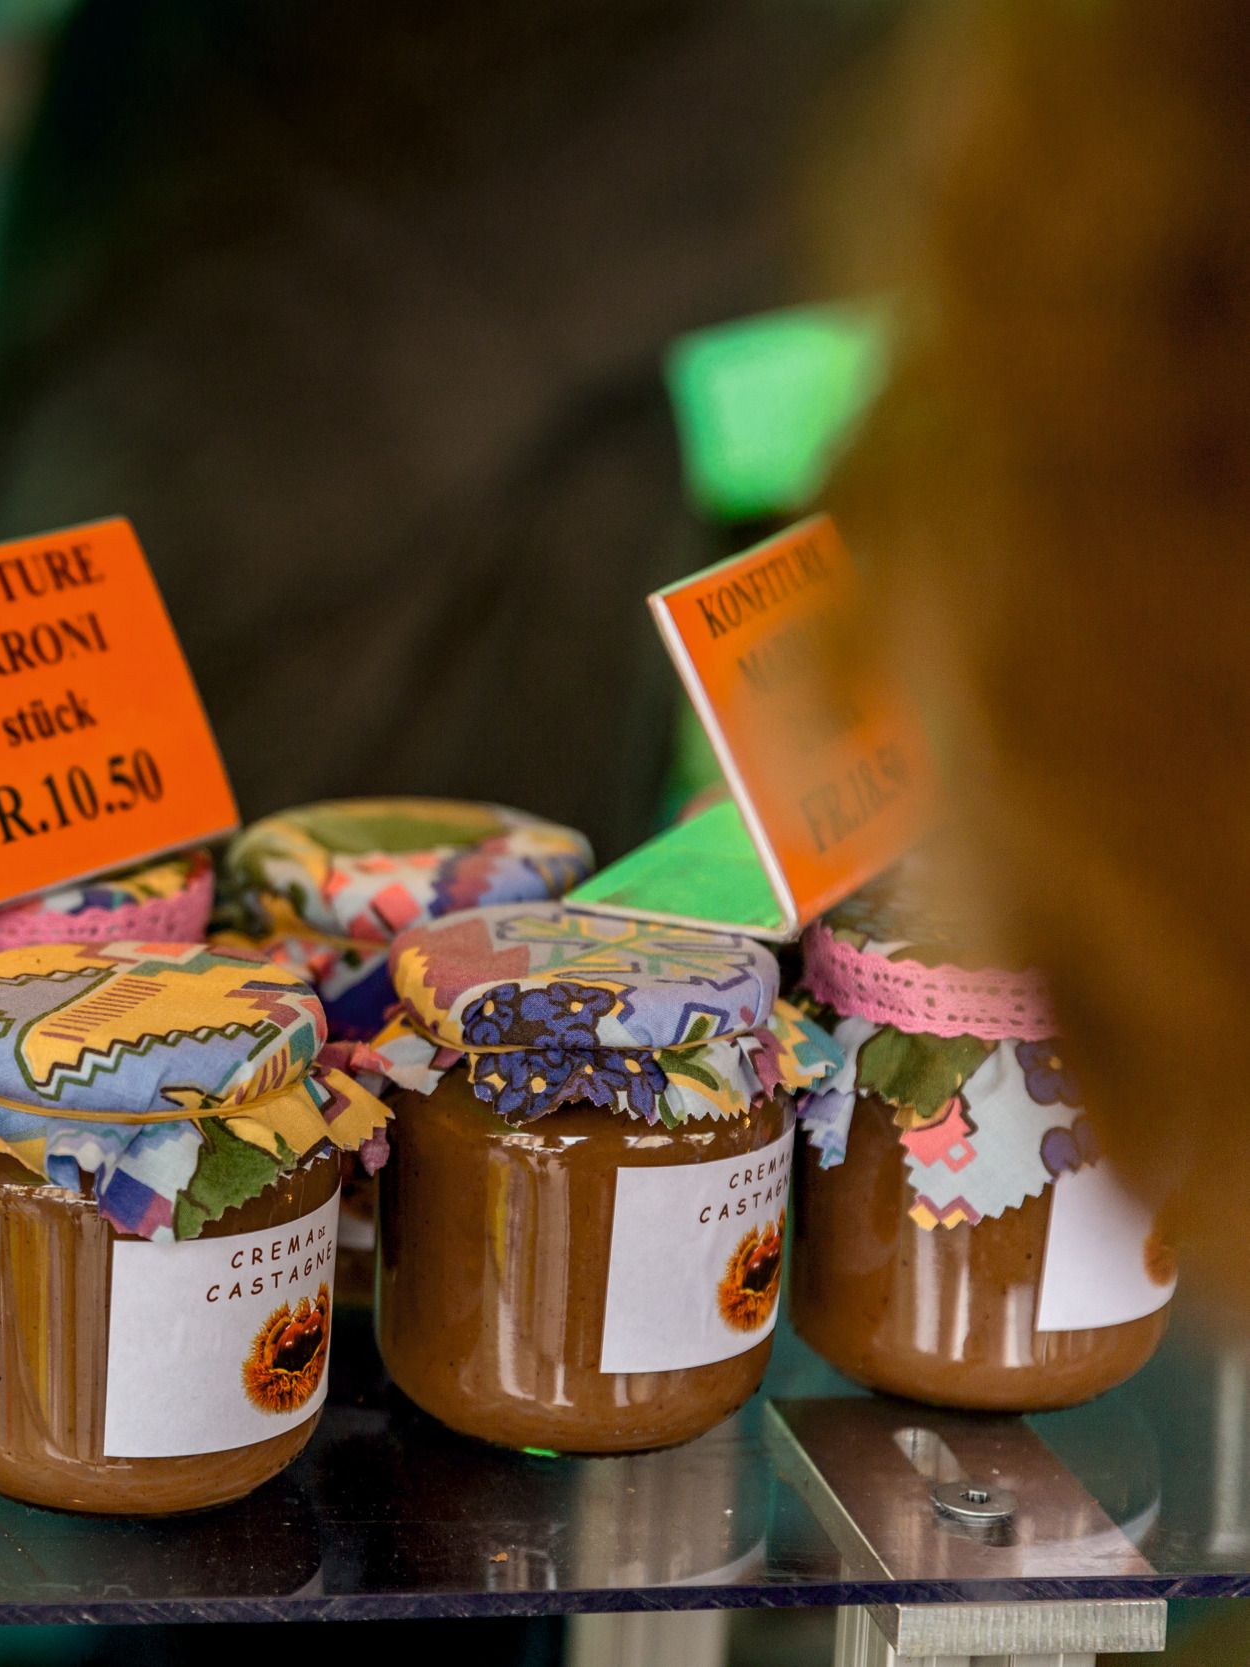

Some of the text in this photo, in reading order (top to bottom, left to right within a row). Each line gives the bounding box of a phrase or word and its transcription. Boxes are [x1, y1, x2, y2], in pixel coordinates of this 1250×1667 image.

[1, 689, 99, 748] stück
[729, 1151, 785, 1189] CREMA
[699, 1171, 790, 1224] CASTAGN
[206, 1239, 334, 1303] CASTAGNE
[230, 1225, 327, 1269] CREMA DI
